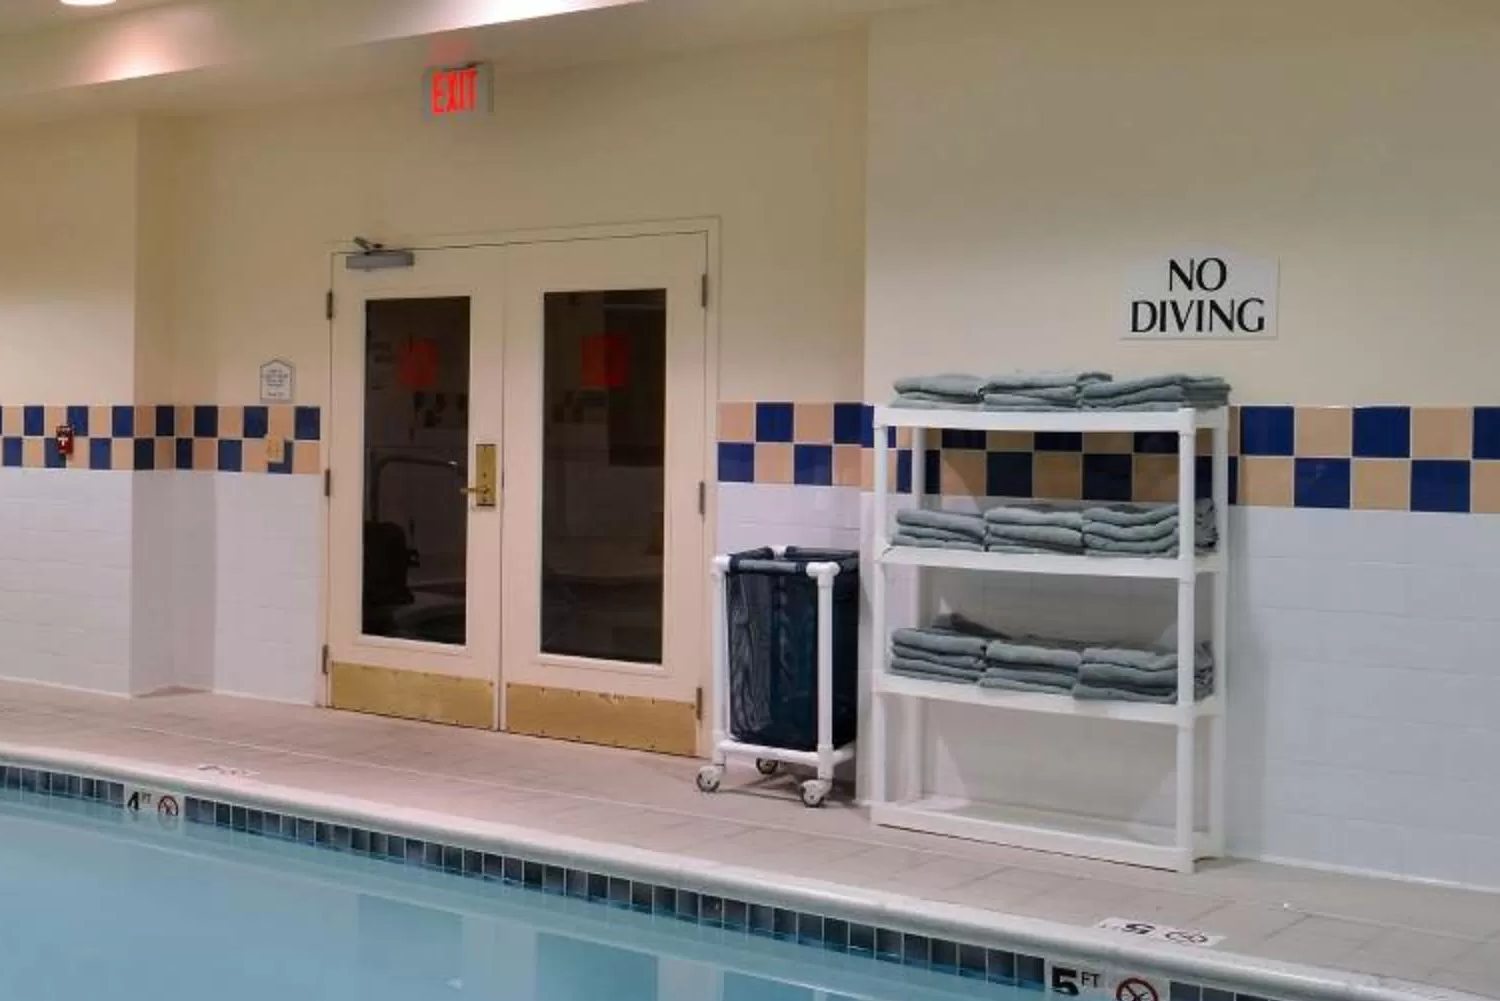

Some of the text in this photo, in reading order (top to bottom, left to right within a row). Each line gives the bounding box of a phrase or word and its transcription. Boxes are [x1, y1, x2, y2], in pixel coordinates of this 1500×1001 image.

[432, 69, 477, 113] EXIT
[1169, 257, 1227, 291] NO
[1131, 298, 1265, 332] DIVING
[1051, 966, 1101, 997] 5 FT
